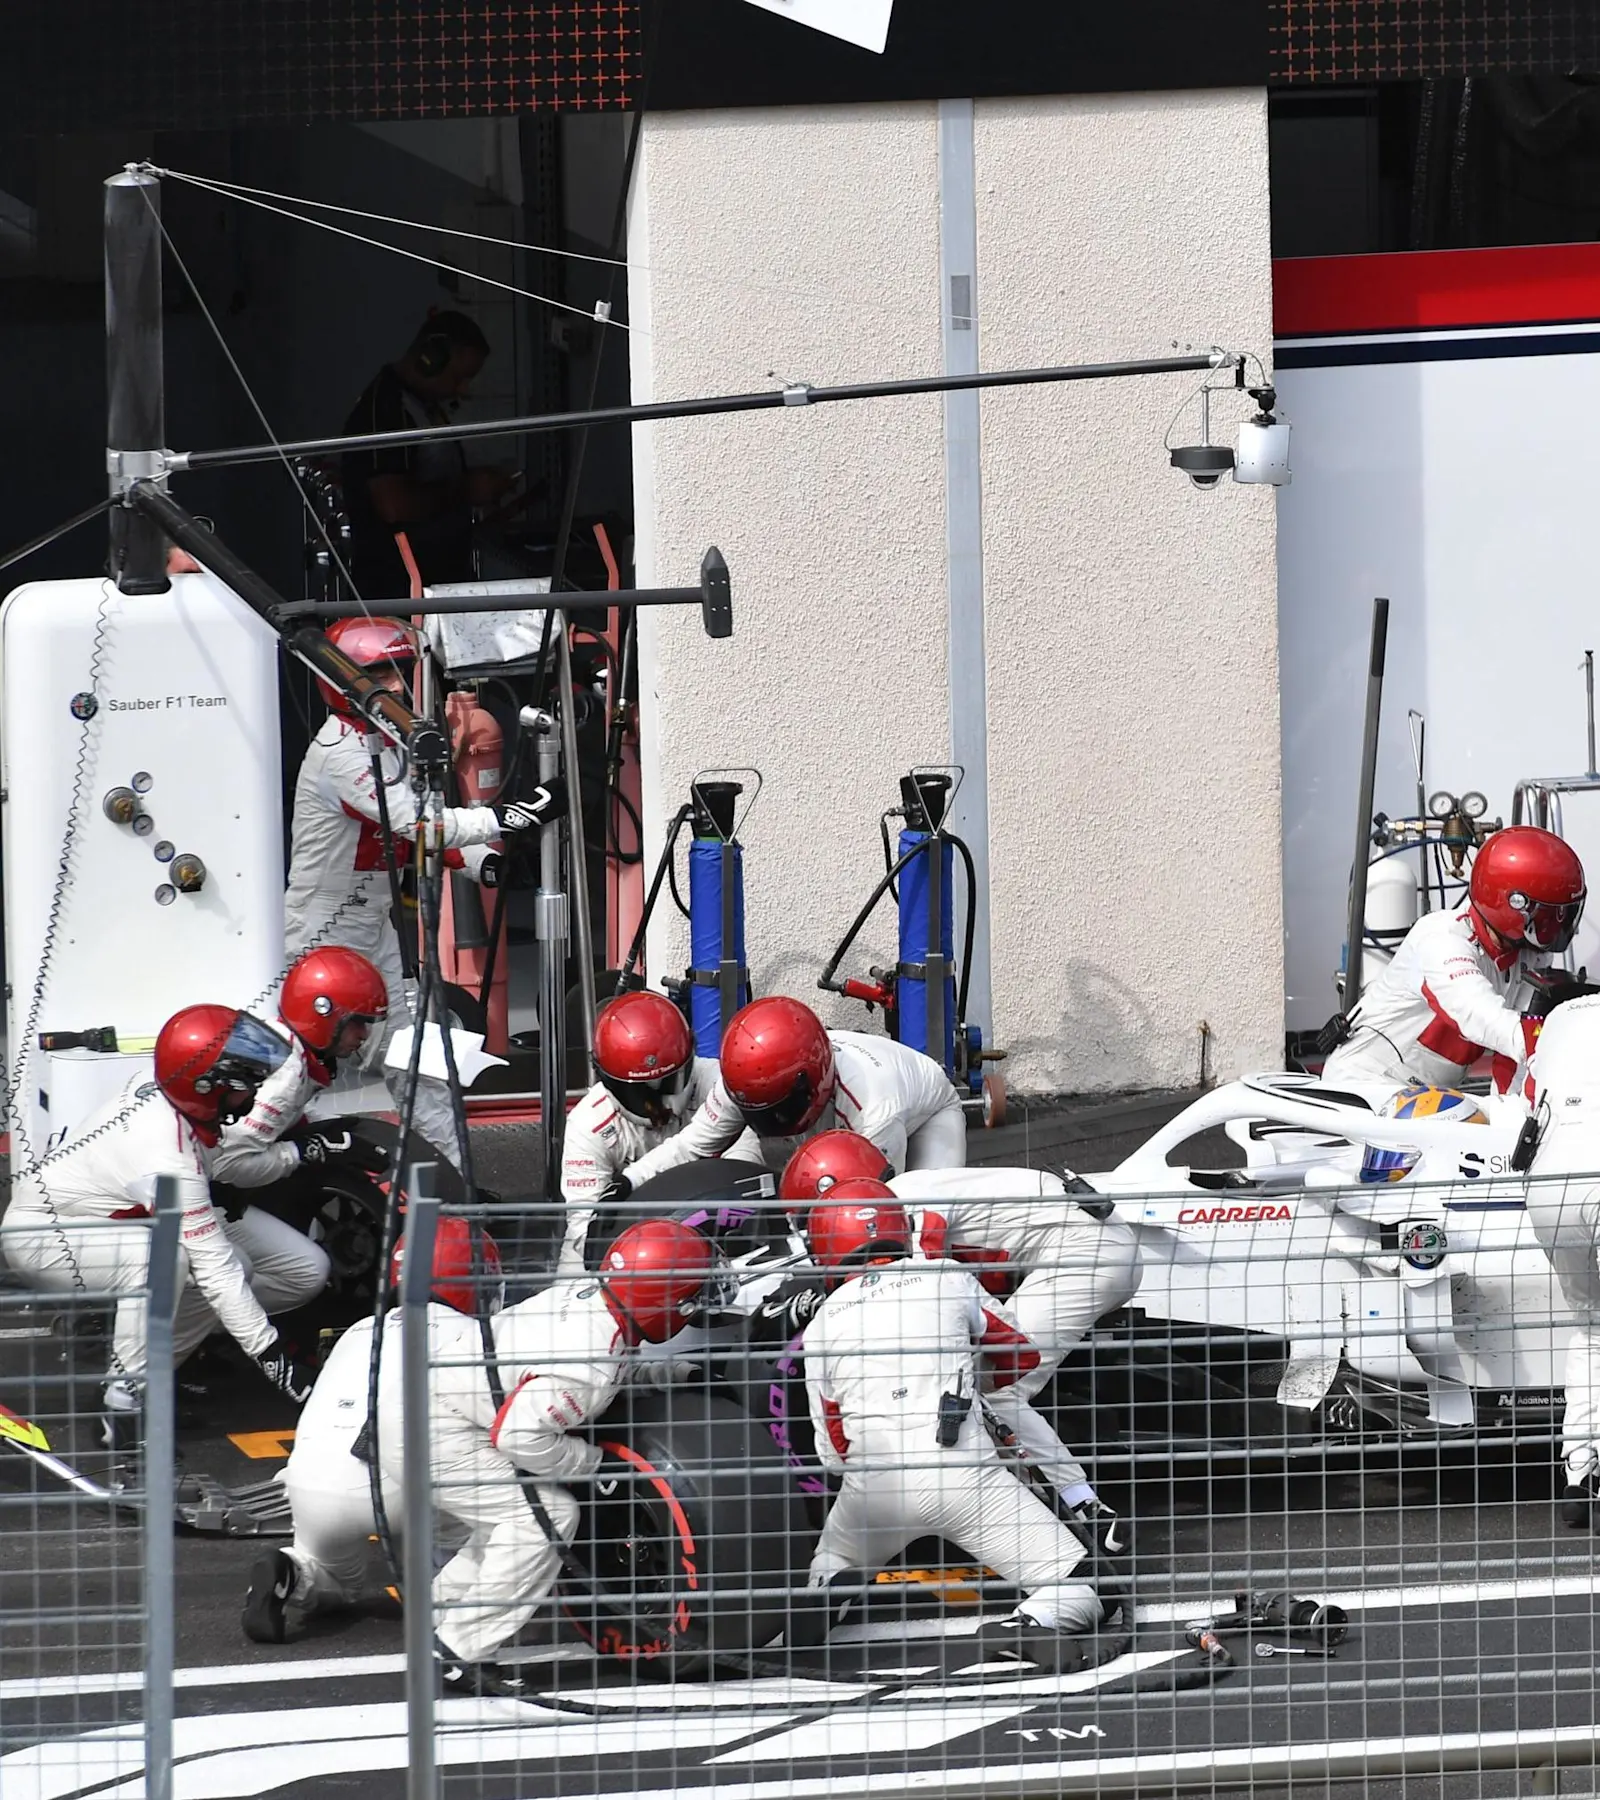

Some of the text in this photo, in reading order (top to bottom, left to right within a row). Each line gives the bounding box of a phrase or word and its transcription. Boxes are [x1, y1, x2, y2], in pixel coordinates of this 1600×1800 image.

[108, 698, 161, 712] Sauber
[188, 695, 227, 708] Team
[1178, 1205, 1292, 1224] CARRERA
[828, 1295, 868, 1319] Sauber
[889, 1275, 923, 1291] Team
[1003, 1725, 1107, 1742] TM
